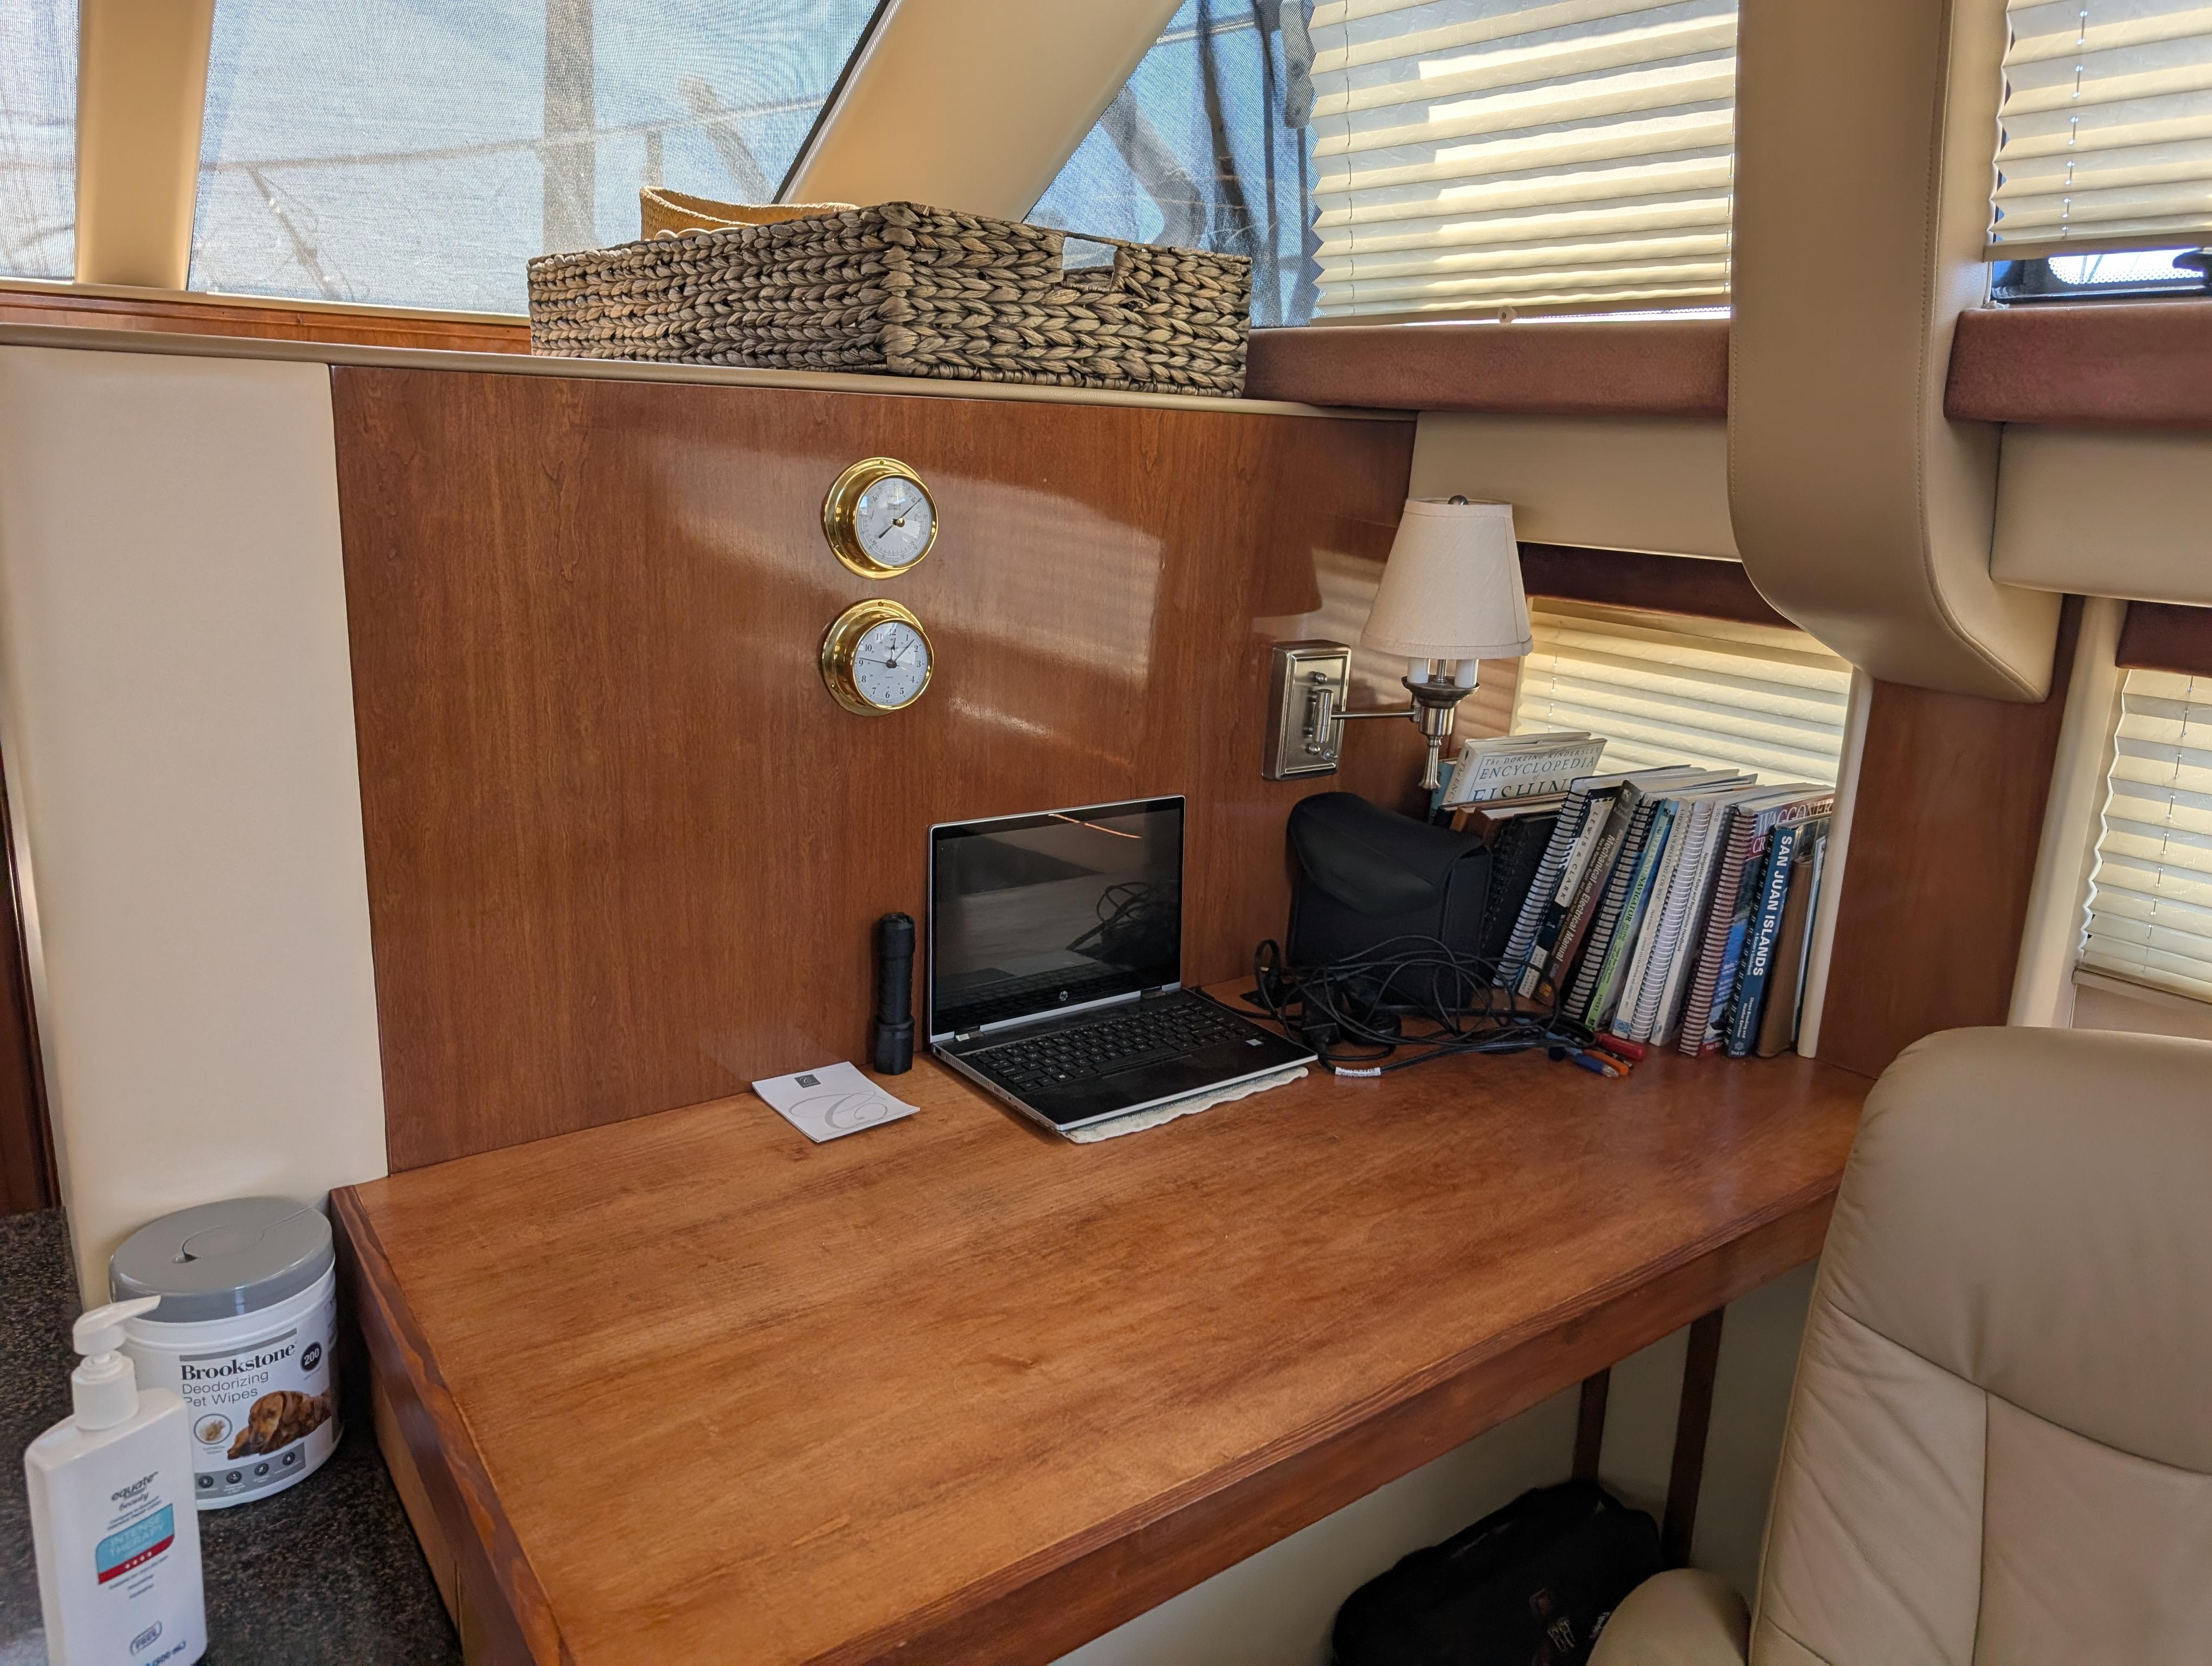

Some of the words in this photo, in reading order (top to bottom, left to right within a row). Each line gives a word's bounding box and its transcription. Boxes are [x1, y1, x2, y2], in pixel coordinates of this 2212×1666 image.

[1478, 757, 1594, 780] ENCYCLOPEDIA
[1485, 758, 1500, 766] The
[1502, 753, 1544, 765] DORLING
[1548, 747, 1602, 759] KINDERSLEY
[1447, 778, 1459, 803] ENC
[1472, 778, 1569, 802] FISHIN
[1581, 811, 1599, 847] LEWIS
[1590, 835, 1615, 885] Mechanical
[1664, 844, 1676, 873] BOATING
[1776, 836, 1792, 867] SAN
[1699, 852, 1709, 880] Navigation
[1560, 863, 1578, 899] CLARK
[1584, 881, 1593, 892] AND
[1656, 874, 1667, 901] COURSE
[1767, 870, 1784, 911] JUAN
[1624, 876, 1646, 924] NAVIGATOR
[1568, 894, 1590, 935] Electrical
[1686, 902, 1695, 929] Regulations
[1555, 930, 1575, 962] Manual
[1677, 929, 1688, 952] Handbook
[1753, 914, 1774, 976] ISLANDS
[180, 1343, 295, 1381] Brookstone
[304, 1348, 320, 1366] 200
[182, 1371, 269, 1395] Deodorizing
[184, 1396, 207, 1407] Pet
[212, 1387, 258, 1407] Wipes
